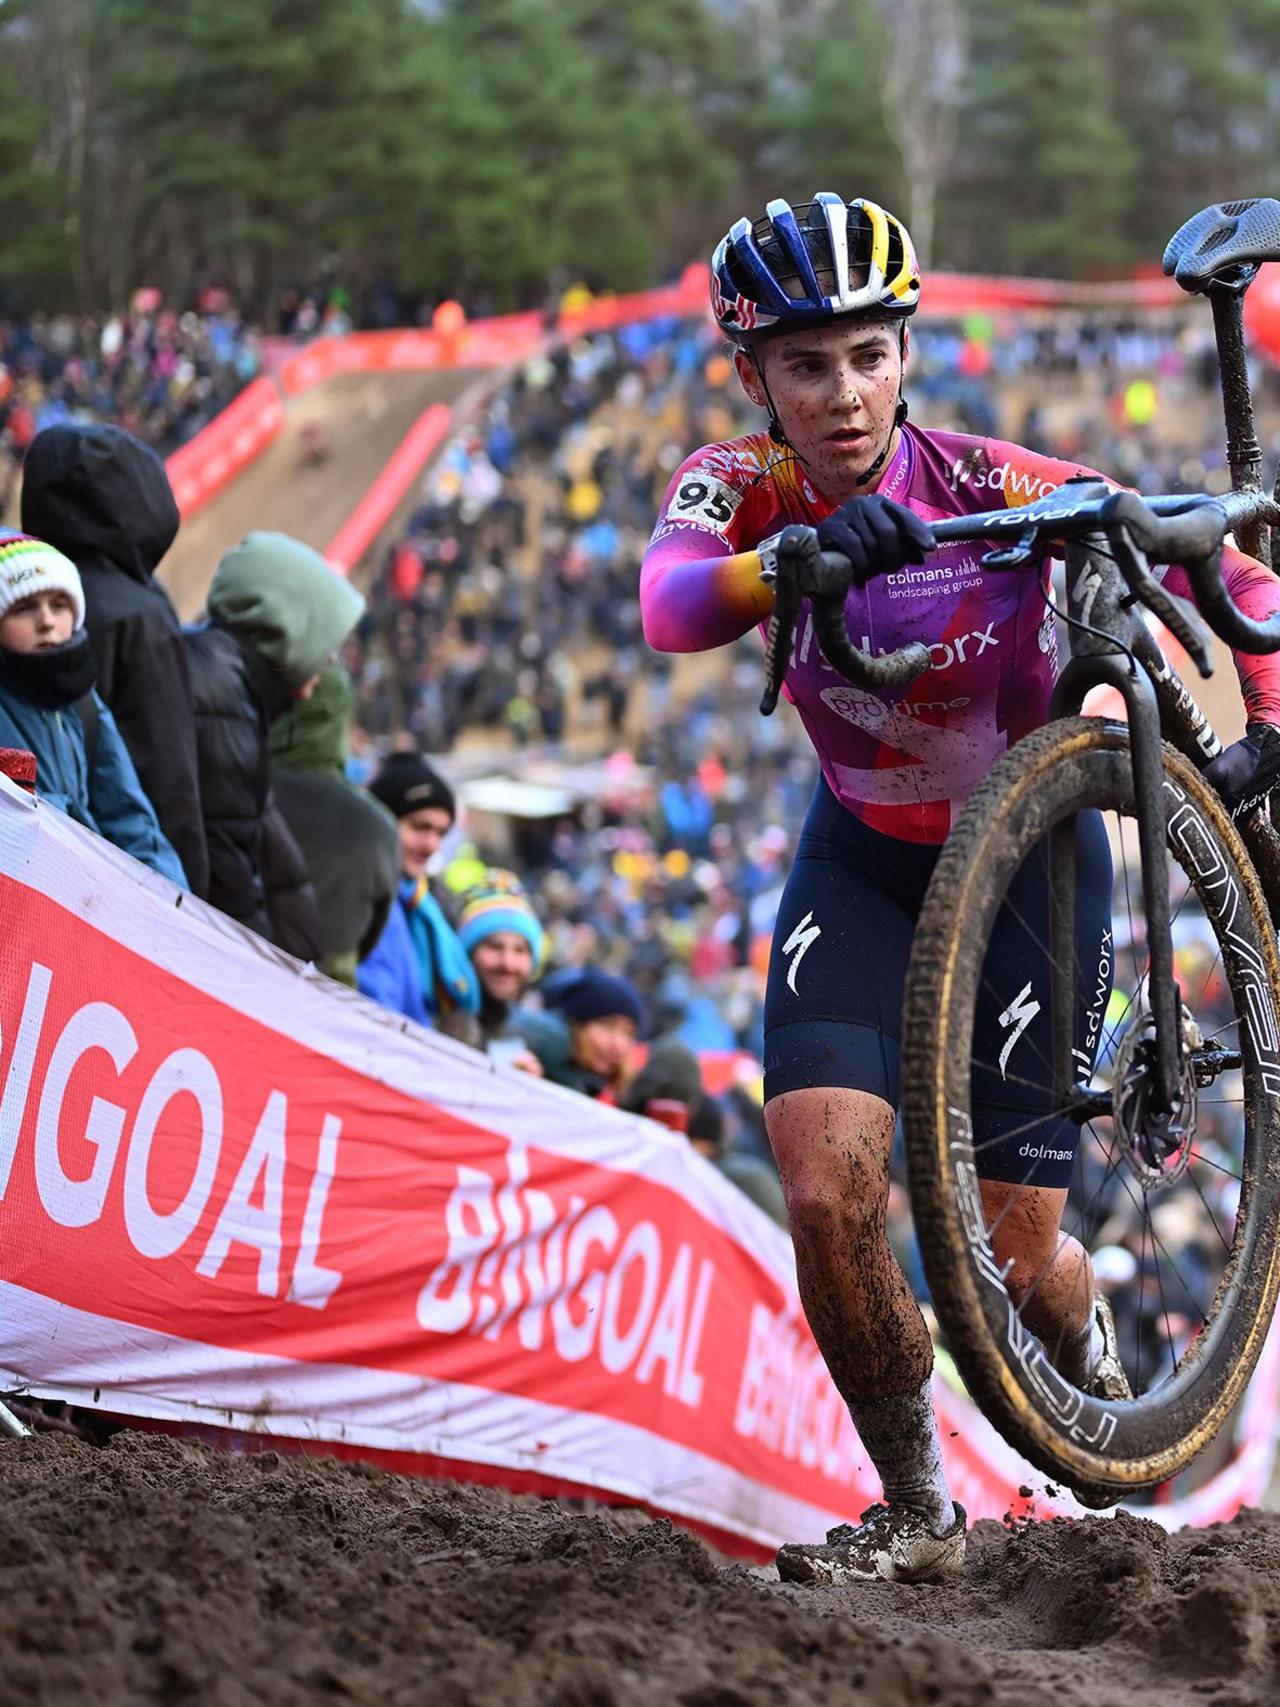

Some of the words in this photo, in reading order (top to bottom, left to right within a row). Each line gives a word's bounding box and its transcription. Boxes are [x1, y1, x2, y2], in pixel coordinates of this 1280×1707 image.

[677, 482, 732, 522] 95
[984, 506, 1082, 526] roval
[888, 582, 951, 599] landscaping
[952, 575, 983, 592] group
[1084, 928, 1112, 1049] sdworx
[1018, 1142, 1073, 1161] dolmans
